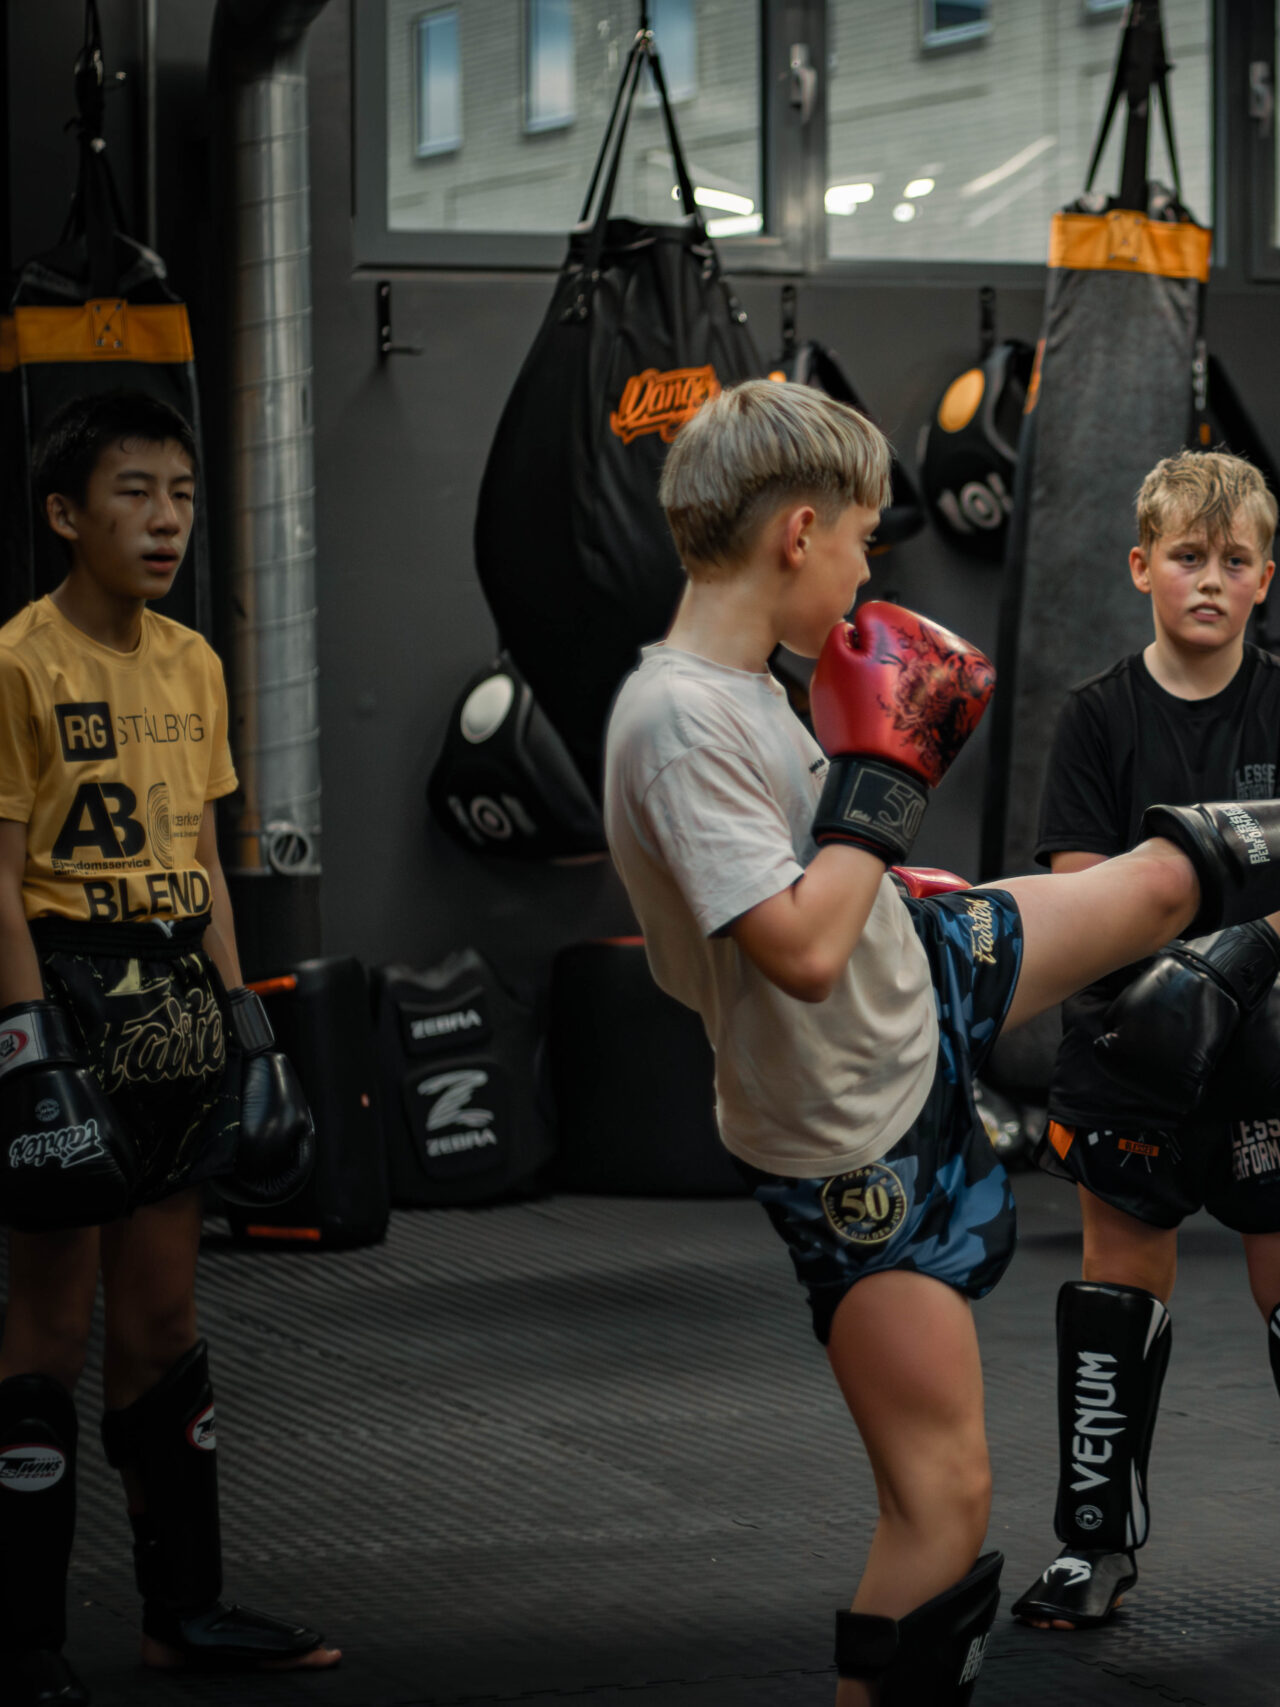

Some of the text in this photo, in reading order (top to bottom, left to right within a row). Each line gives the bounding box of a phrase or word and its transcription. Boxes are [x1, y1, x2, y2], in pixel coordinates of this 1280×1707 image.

[63, 708, 206, 751] RG STÅLBYG
[1235, 763, 1277, 787] LESSE
[51, 782, 147, 860] AB
[1217, 804, 1262, 865] BLESSE
[84, 871, 211, 922] BLEND
[9, 1118, 105, 1168] Fairtex
[841, 1184, 891, 1223] 50
[1070, 1350, 1128, 1493] VENUM
